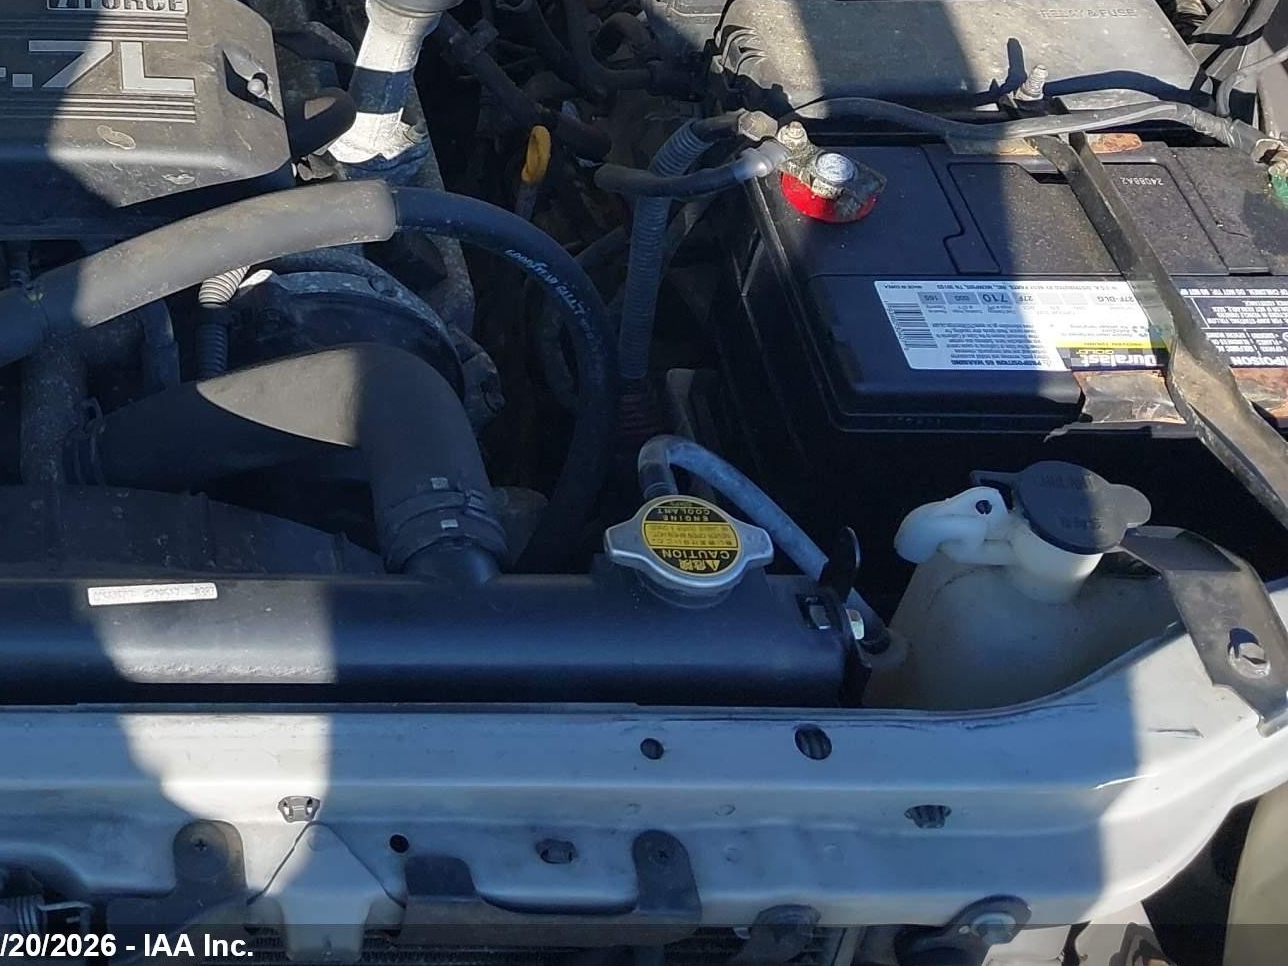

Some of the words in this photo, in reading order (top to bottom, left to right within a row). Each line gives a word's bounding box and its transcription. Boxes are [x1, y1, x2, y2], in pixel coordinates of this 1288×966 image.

[1039, 8, 1083, 18] RELAY
[1098, 8, 1138, 18] FUSE
[982, 294, 1008, 303] 710
[1080, 354, 1157, 366] Duralast
[662, 549, 730, 559] CAUTION
